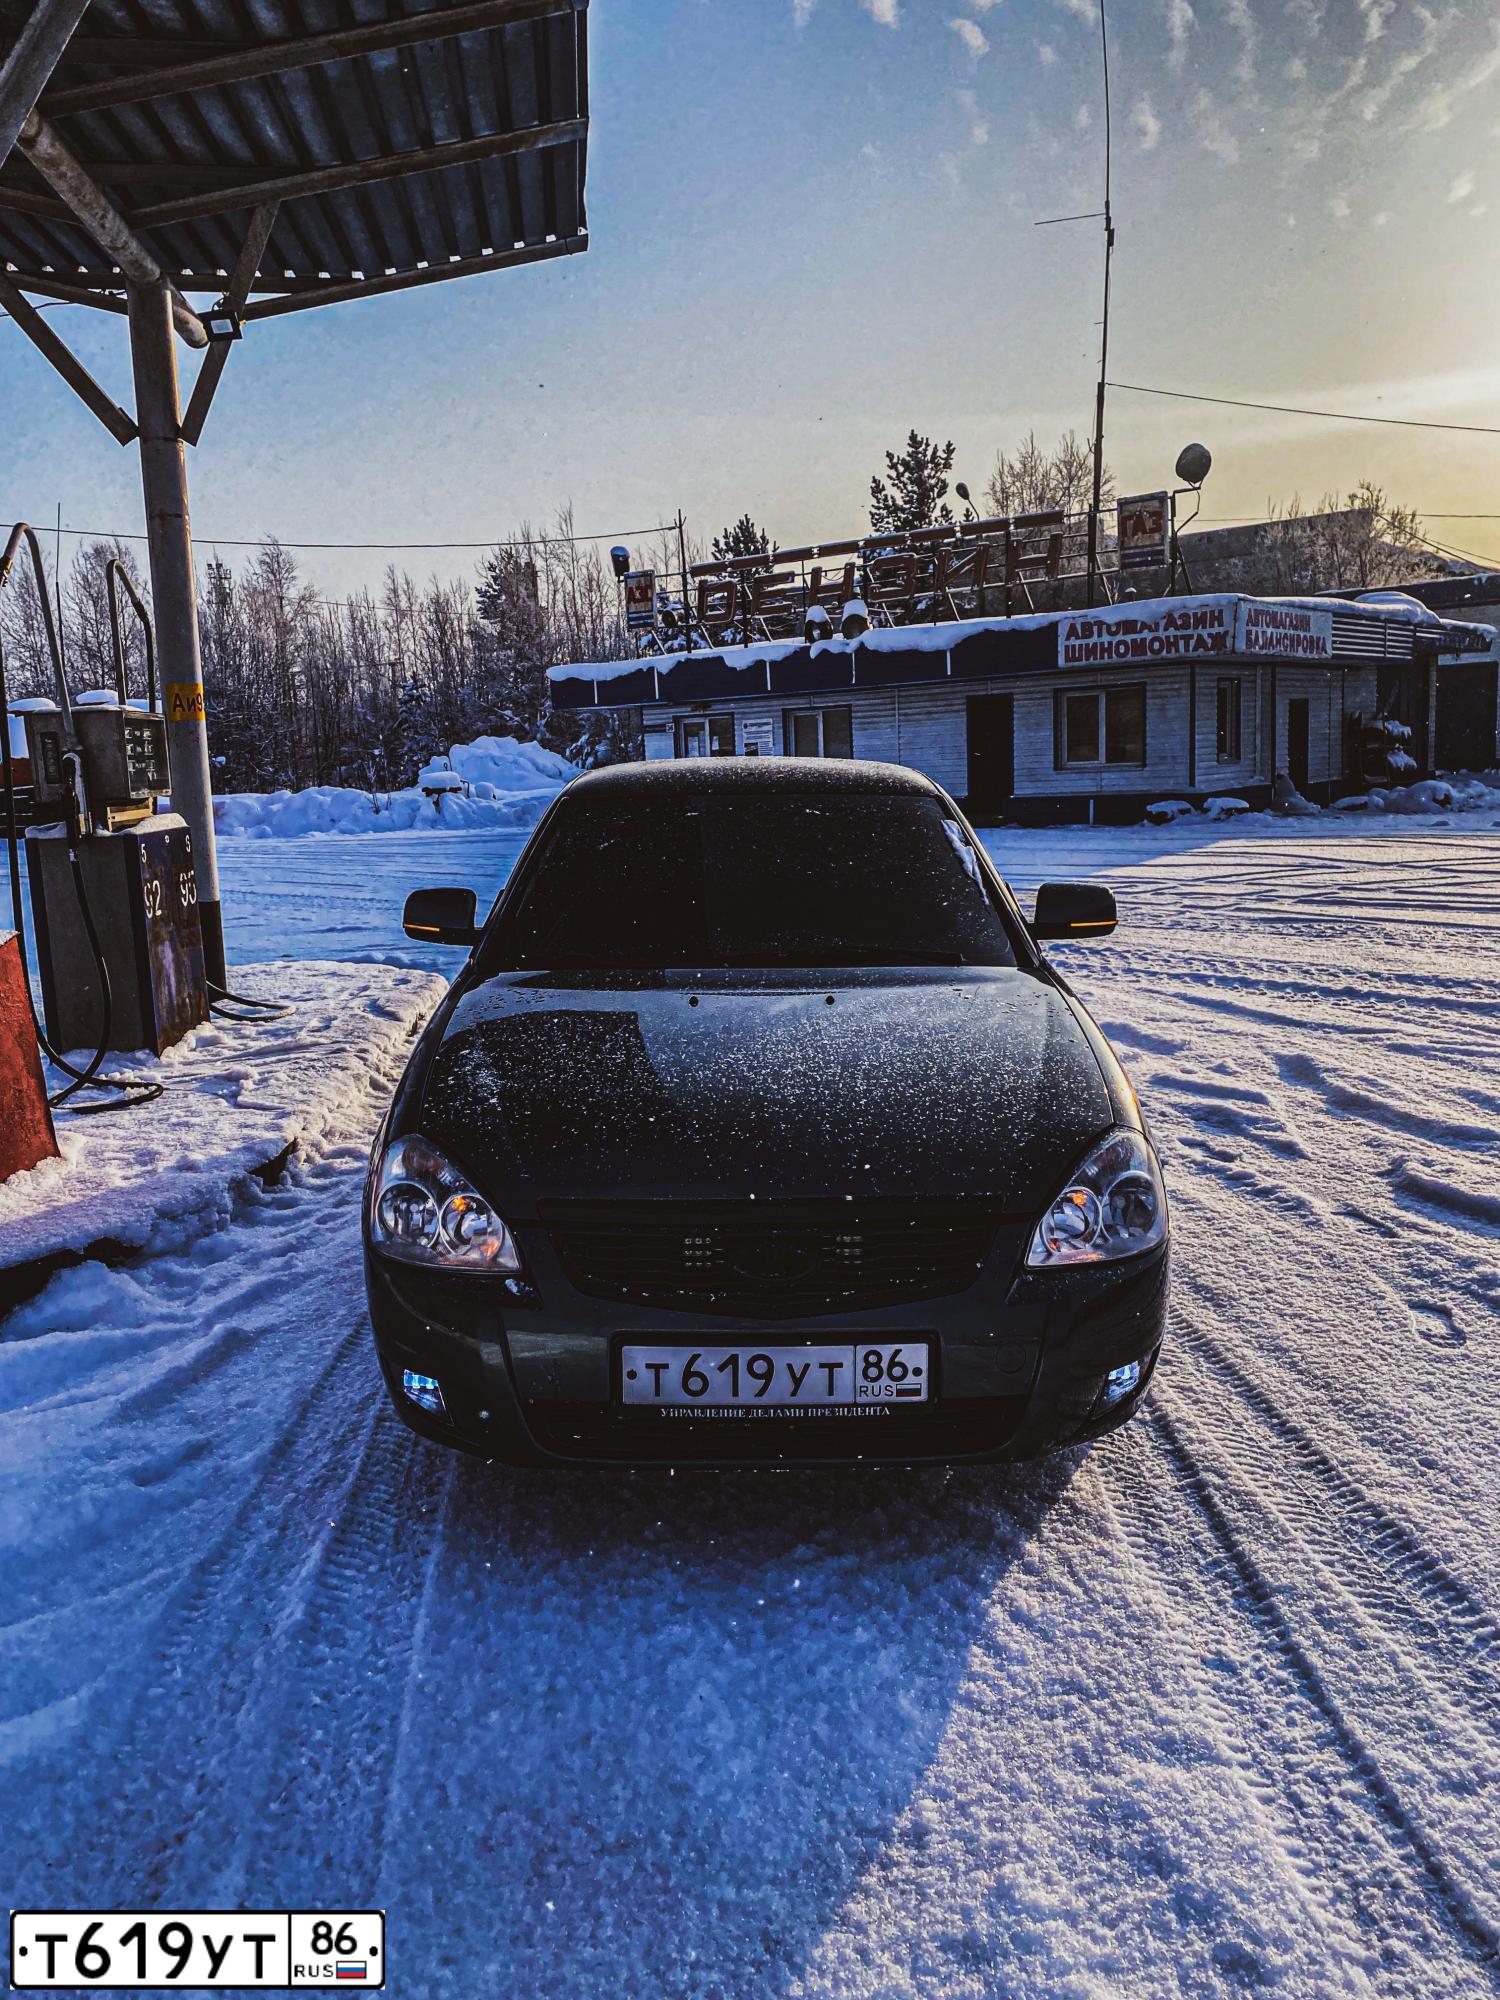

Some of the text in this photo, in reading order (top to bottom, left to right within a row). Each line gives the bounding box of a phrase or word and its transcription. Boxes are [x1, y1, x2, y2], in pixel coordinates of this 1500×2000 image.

[1246, 607, 1311, 633] АВТОМАГАЗИН
[1064, 630, 1229, 663] ШИНОМОНТАЖ
[1246, 629, 1328, 655] БАЛАНСИРОВКА
[861, 1348, 909, 1383] 86
[859, 1384, 894, 1398] RUS
[660, 1405, 890, 1419] УПРАВЛЕНИЕ ДЕЛАМИ ПРЕЗИДЕНТА
